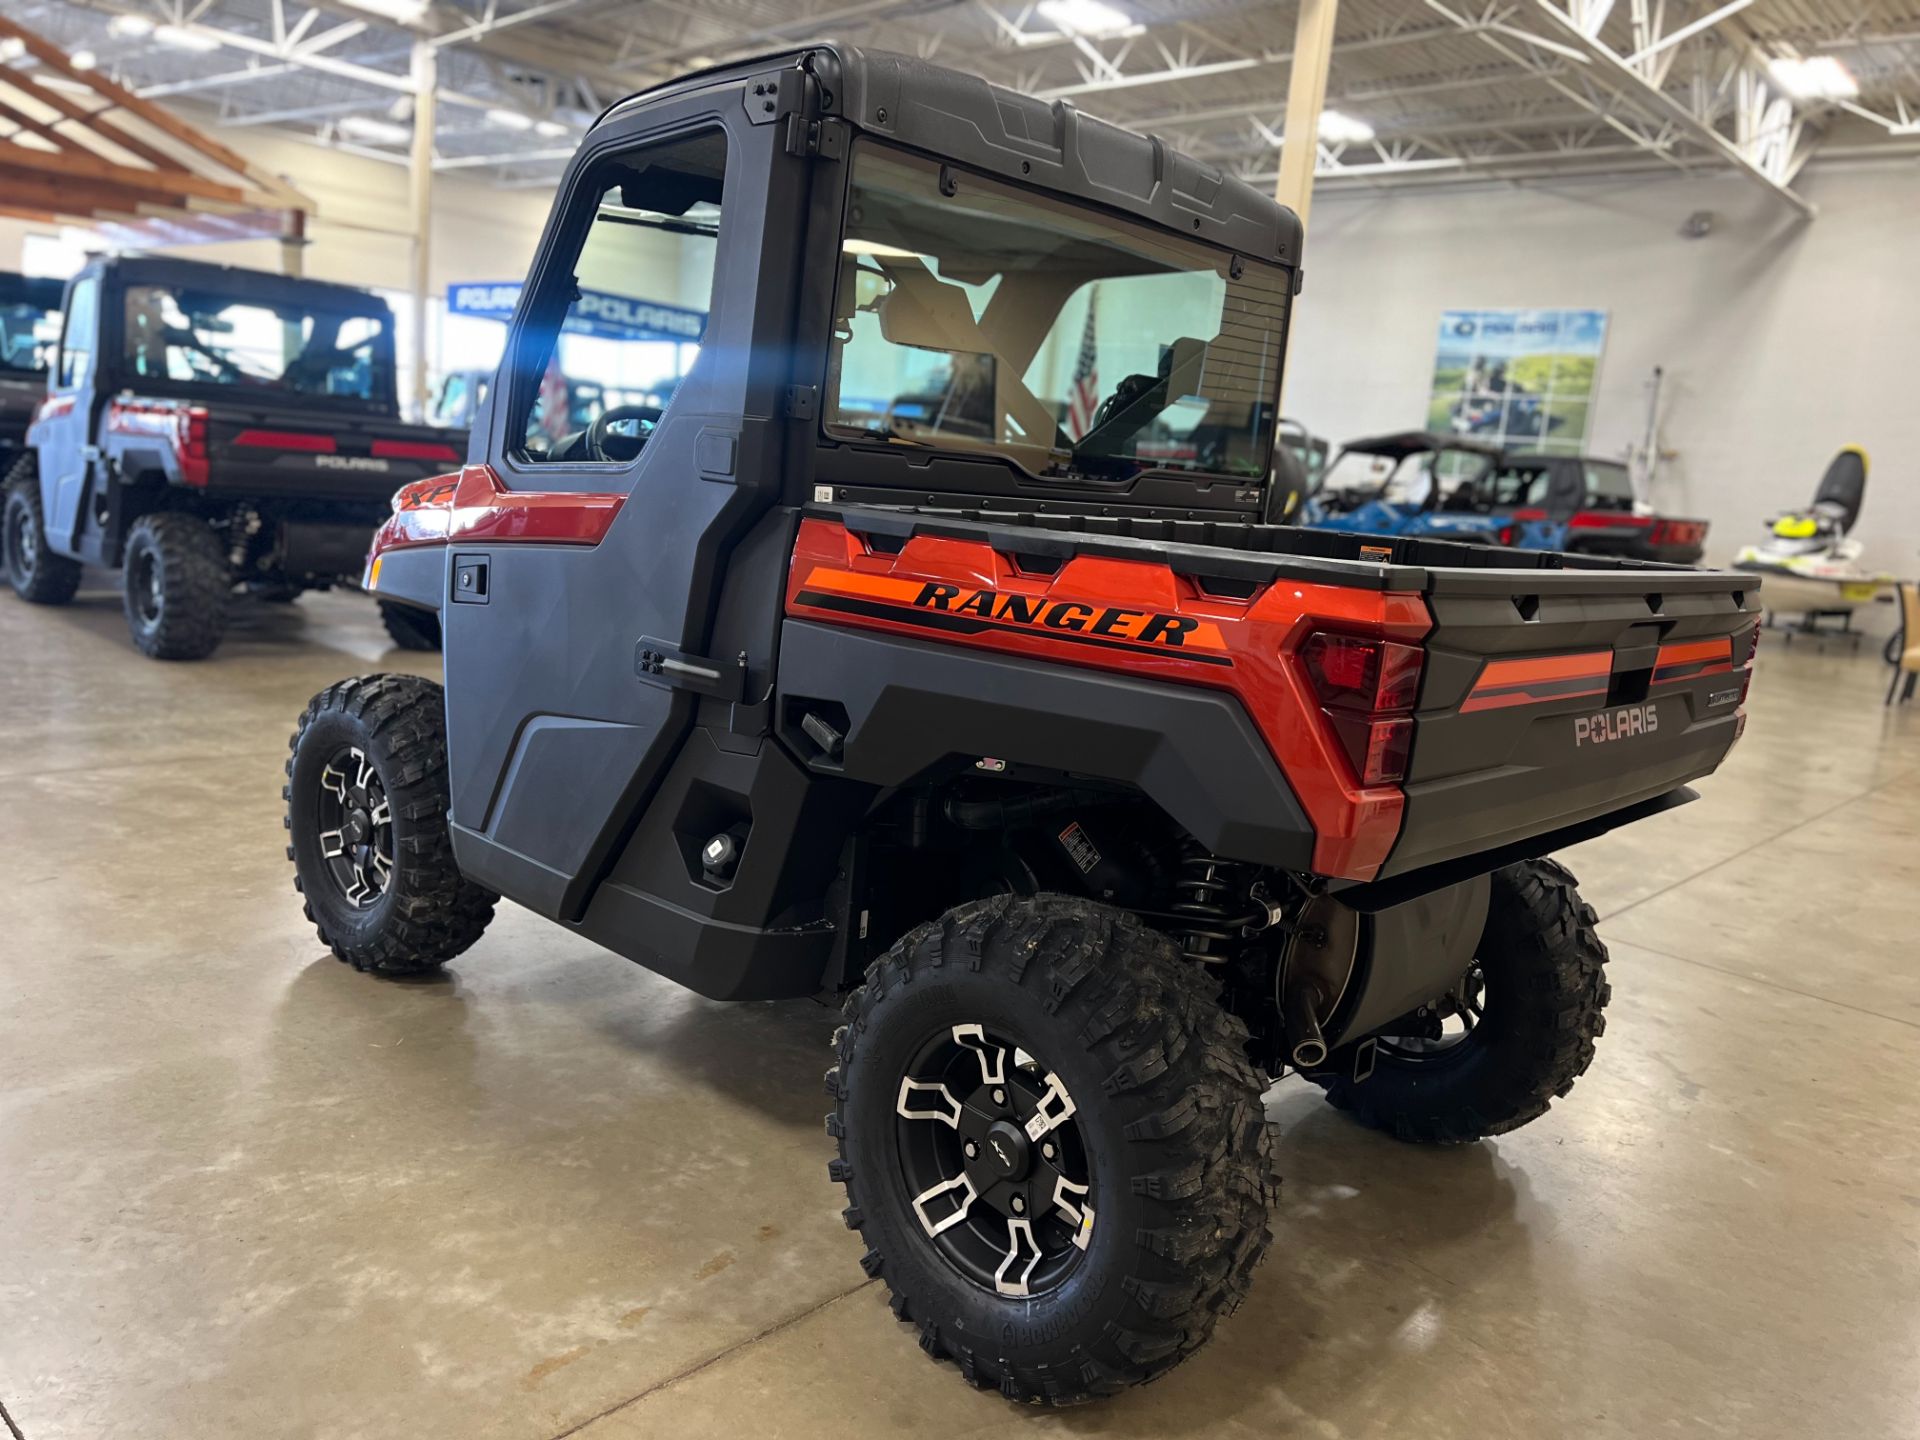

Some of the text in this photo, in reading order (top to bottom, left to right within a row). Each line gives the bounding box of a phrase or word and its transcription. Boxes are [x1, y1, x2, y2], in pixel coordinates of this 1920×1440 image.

[456, 287, 522, 309] POLAR
[577, 292, 701, 337] POLARIS
[315, 454, 389, 472] POLARIS
[912, 582, 1198, 646] RANGER
[1574, 704, 1658, 747] POLARIS
